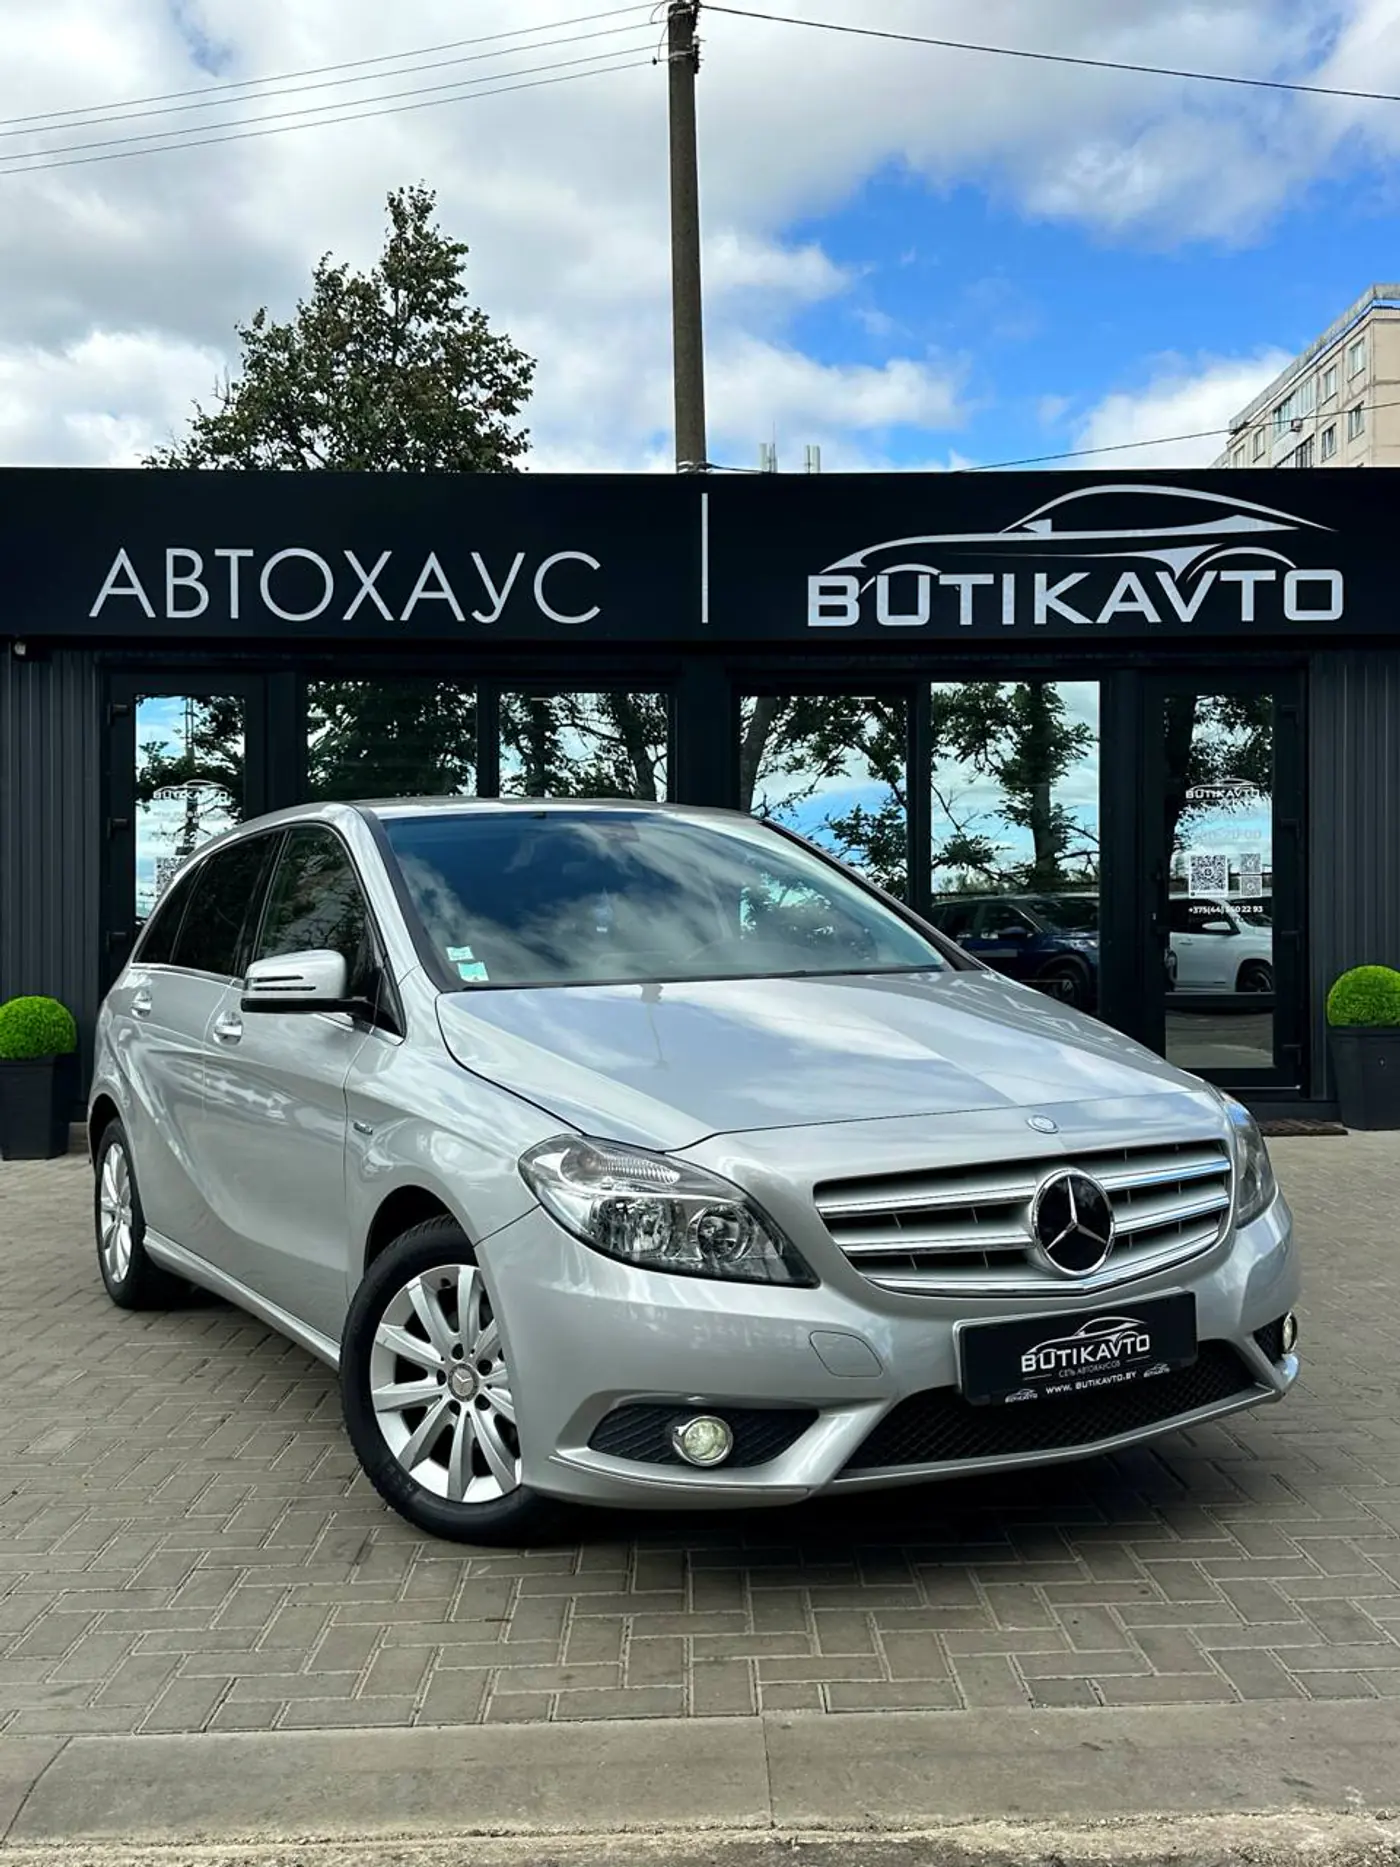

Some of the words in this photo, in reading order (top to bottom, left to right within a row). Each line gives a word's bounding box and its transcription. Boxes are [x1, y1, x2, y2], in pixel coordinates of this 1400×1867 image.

[88, 547, 602, 624] АВТОХАУС
[807, 569, 1344, 627] BUTIKAVTO
[1021, 1334, 1151, 1373] BUTIKAVTO
